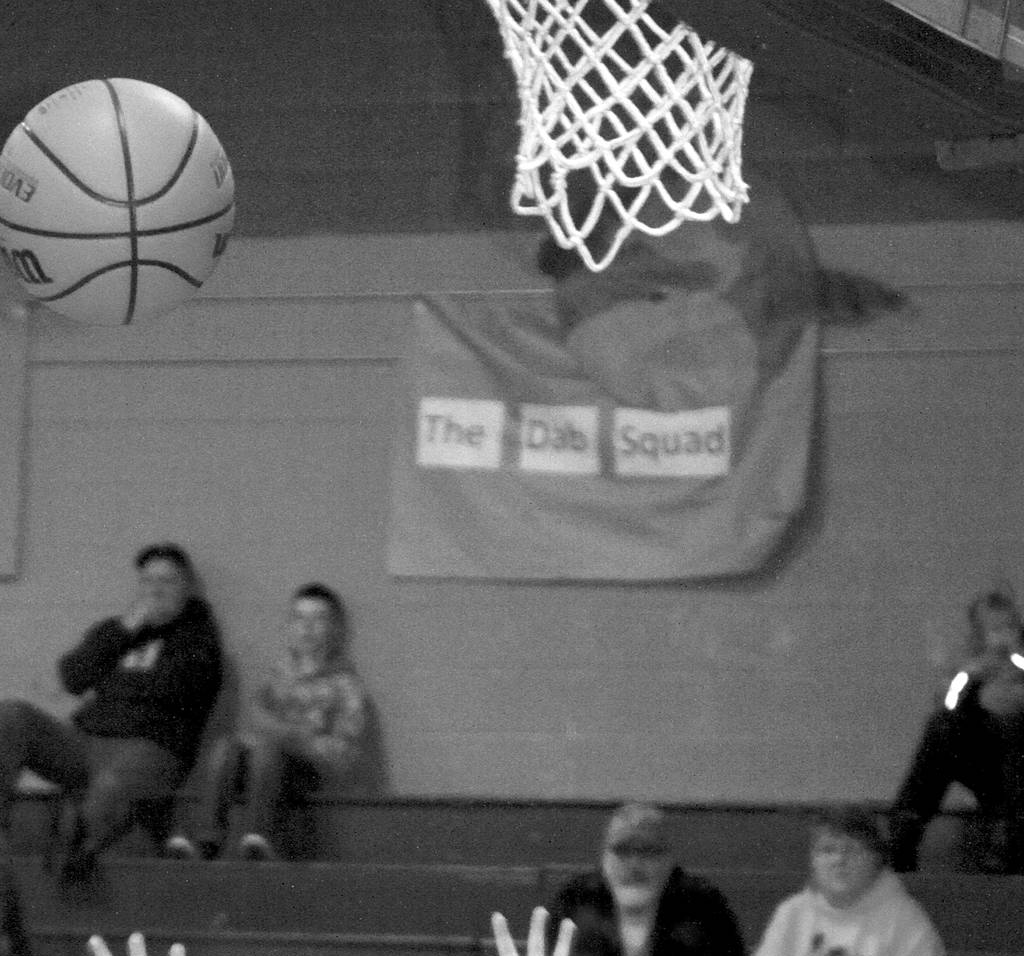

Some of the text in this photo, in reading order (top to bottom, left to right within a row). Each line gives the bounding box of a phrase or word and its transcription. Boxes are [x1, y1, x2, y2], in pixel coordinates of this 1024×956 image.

[425, 413, 726, 462] The Dab Squad
